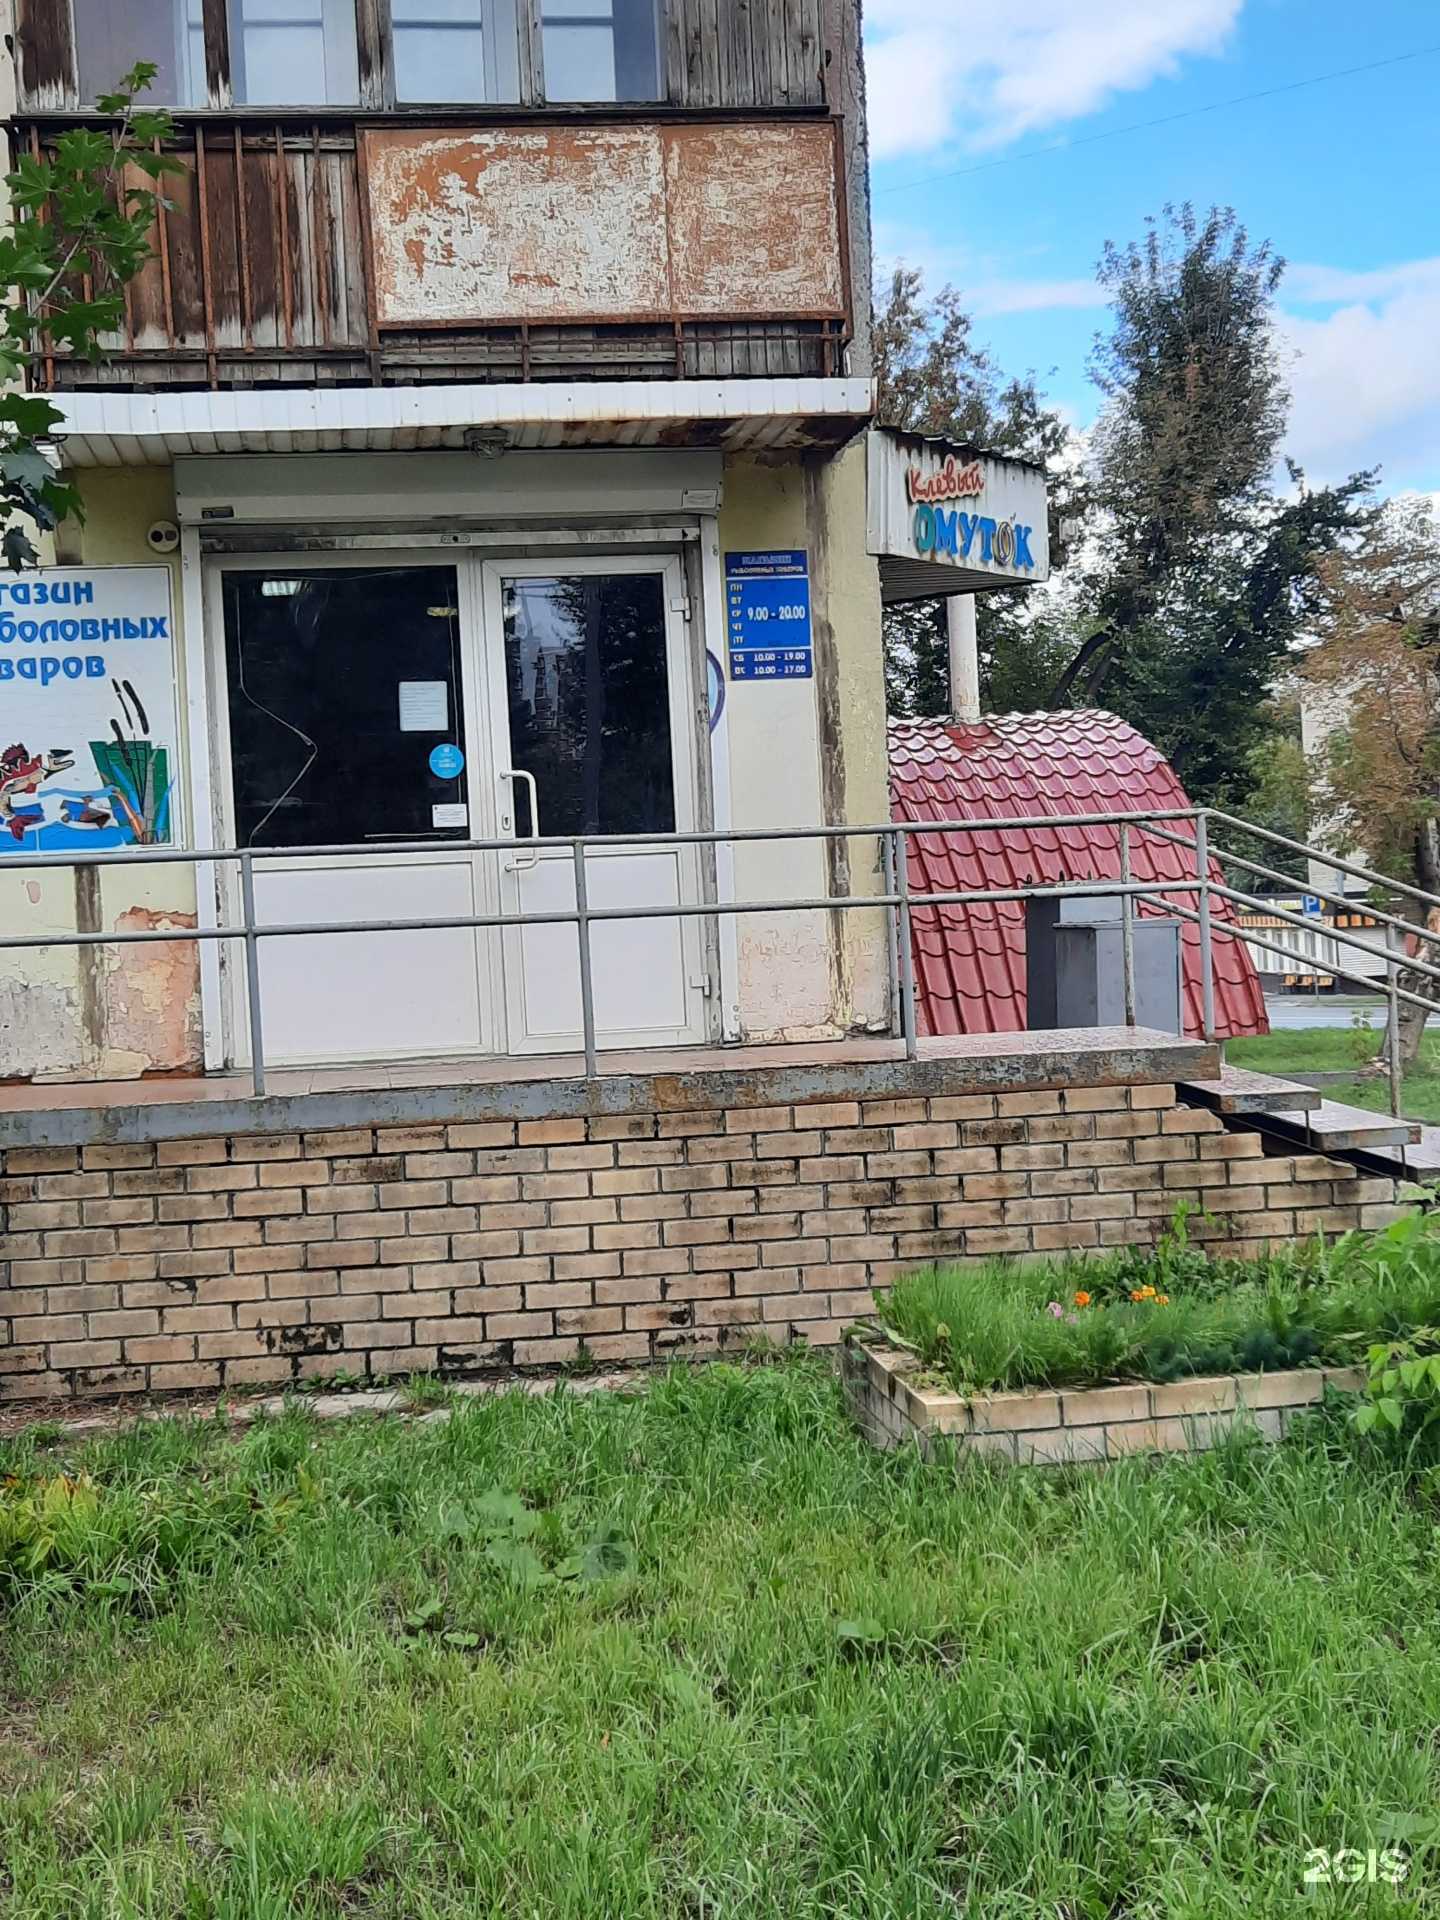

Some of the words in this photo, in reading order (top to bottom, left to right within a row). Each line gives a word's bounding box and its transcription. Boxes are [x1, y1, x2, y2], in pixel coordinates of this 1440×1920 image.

[915, 502, 1034, 568] ОМУТОК
[747, 607, 769, 621] 9.00
[778, 605, 806, 620] 20.00
[0, 611, 169, 643] боловных
[754, 652, 776, 662] 10.00
[0, 656, 106, 686] варов
[754, 666, 776, 675] 10.00
[784, 664, 807, 674] 17.00
[1305, 896, 1317, 912] P
